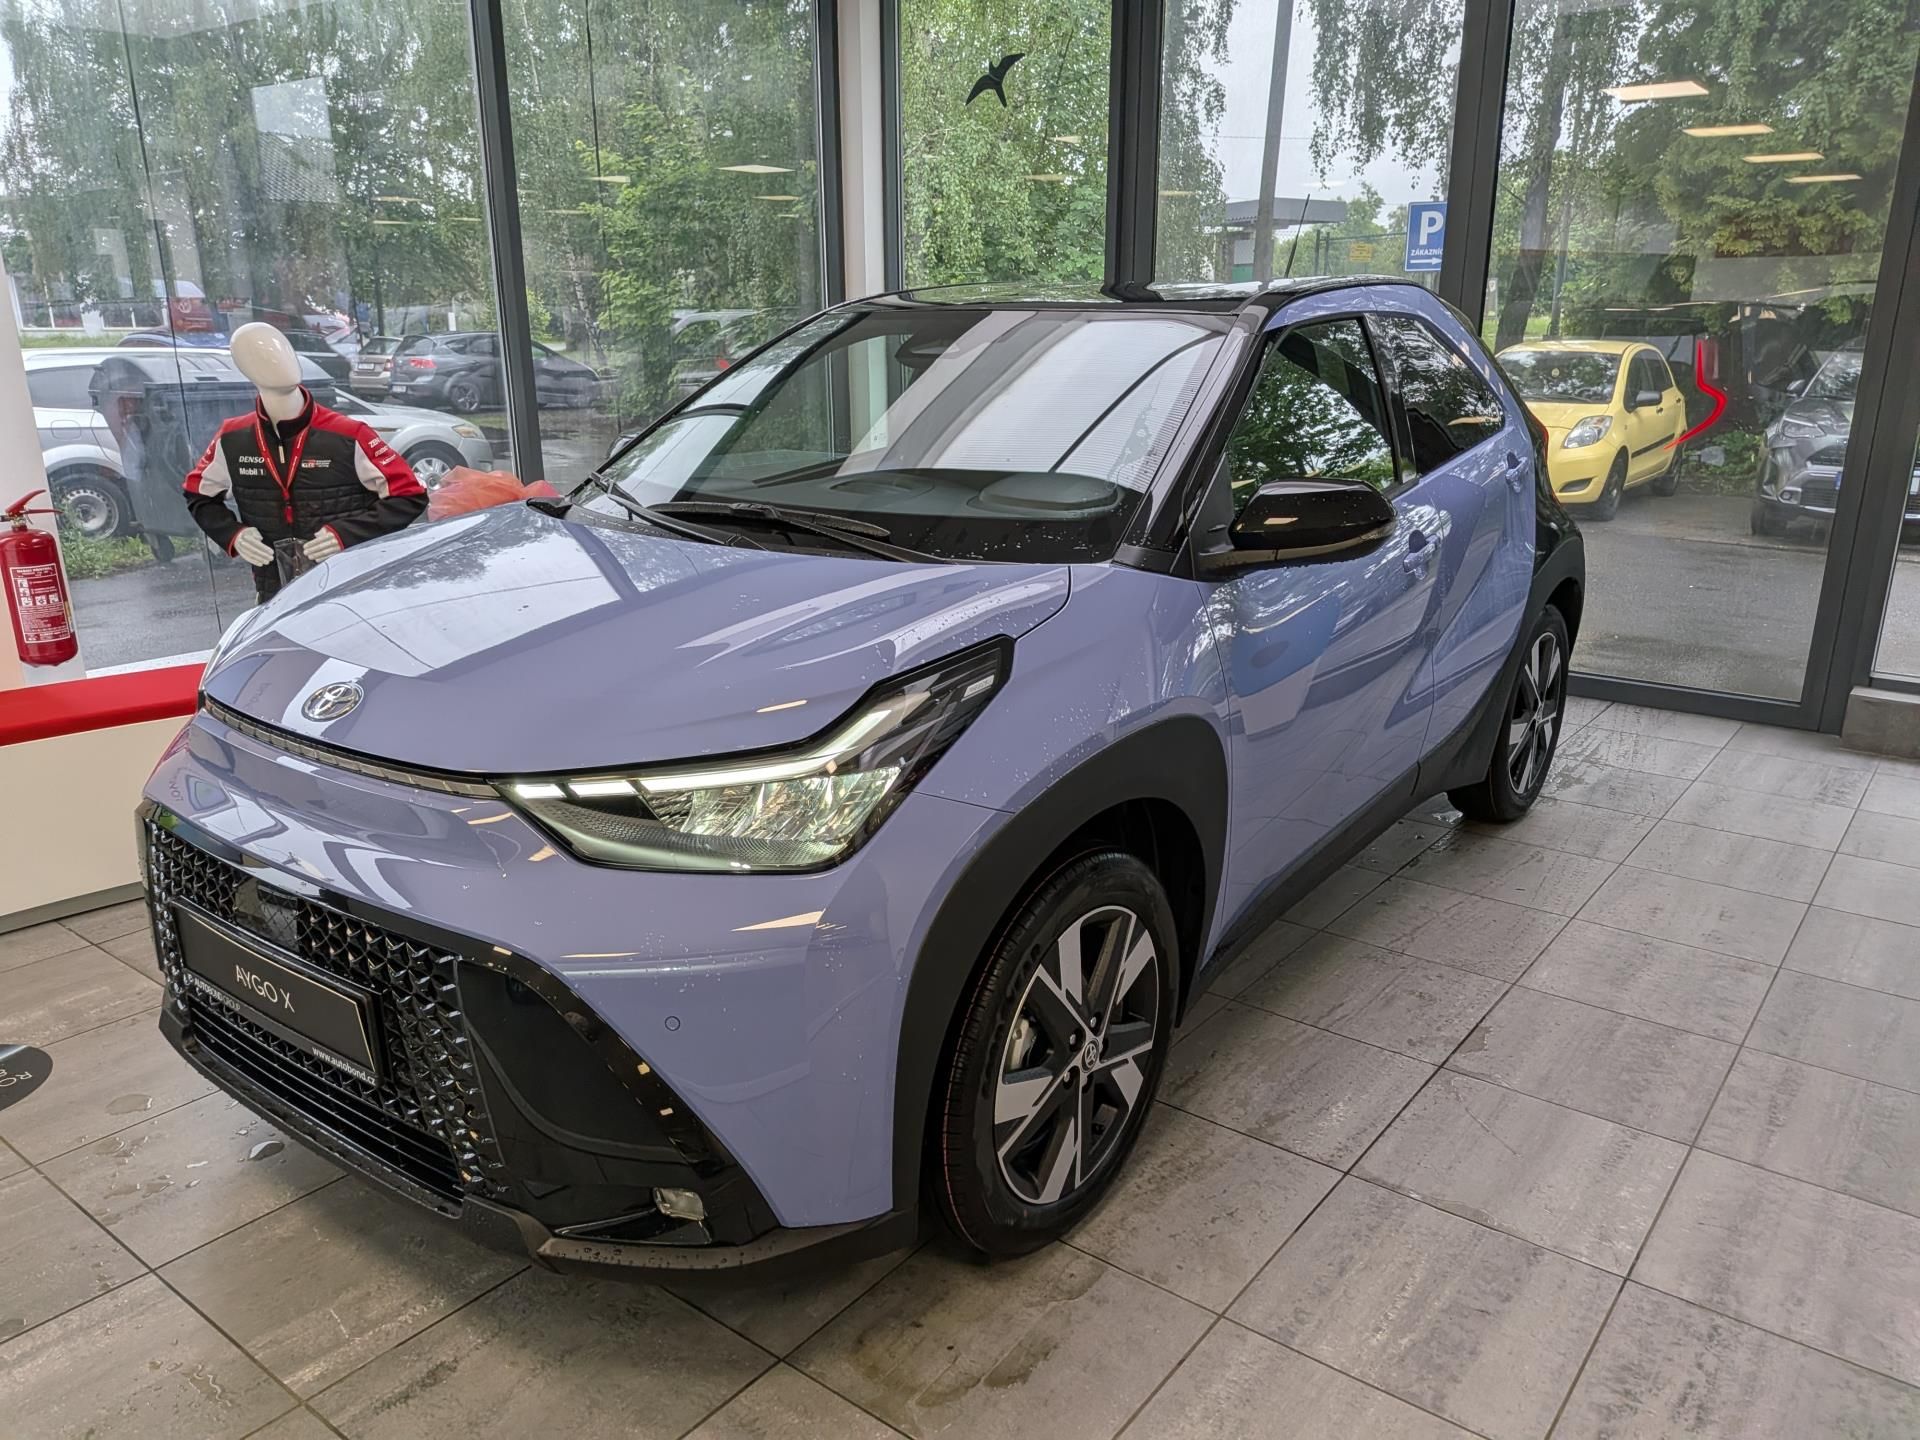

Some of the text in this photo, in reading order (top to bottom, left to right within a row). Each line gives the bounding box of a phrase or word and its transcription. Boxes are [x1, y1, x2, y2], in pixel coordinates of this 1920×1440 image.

[1419, 210, 1444, 246] P
[238, 455, 265, 464] DENSO
[239, 467, 258, 476] Mobil
[235, 964, 295, 1014] AYGO X
[311, 1046, 377, 1087] www.autobond.cz
